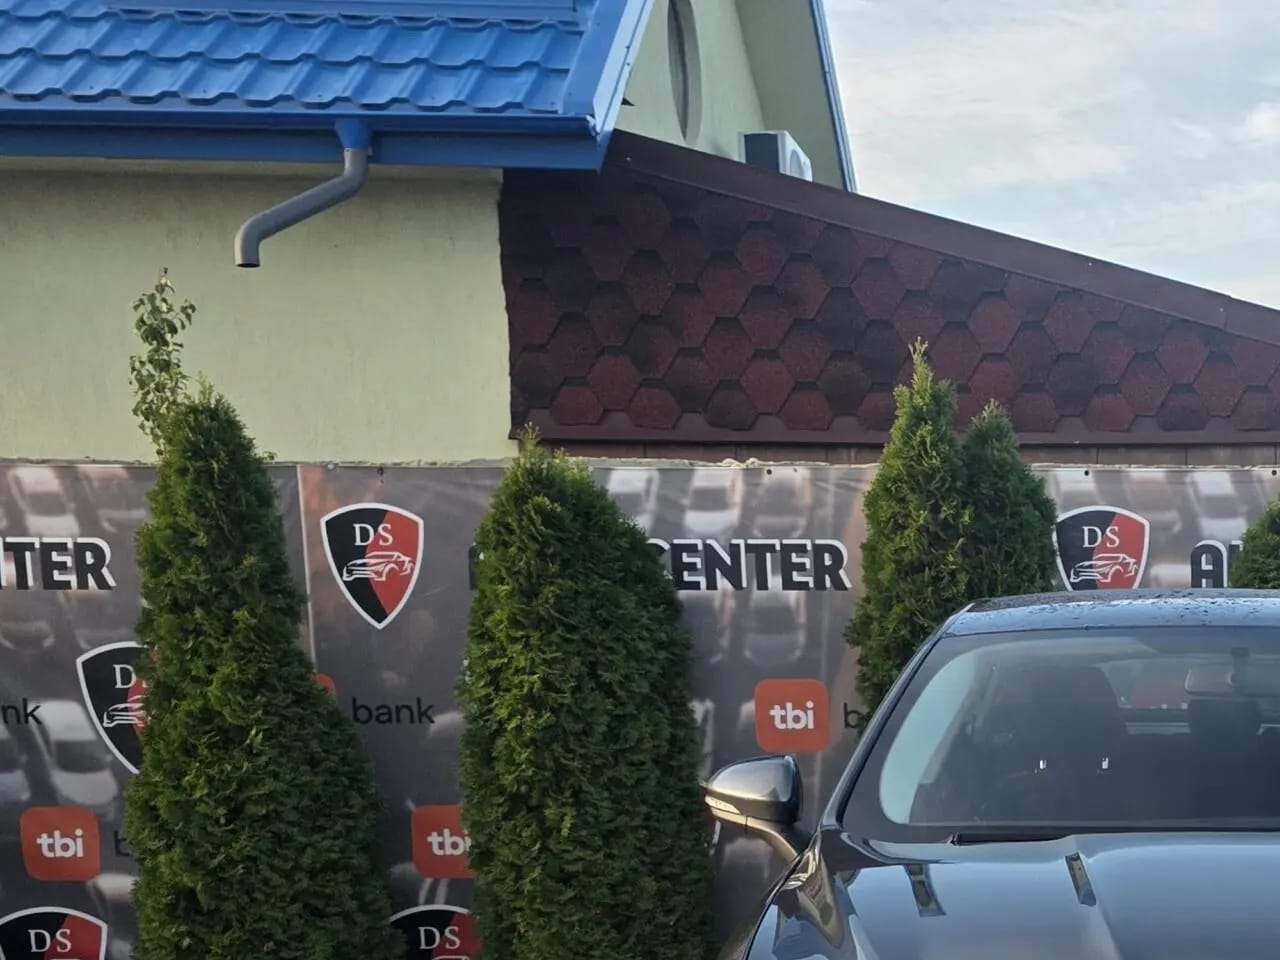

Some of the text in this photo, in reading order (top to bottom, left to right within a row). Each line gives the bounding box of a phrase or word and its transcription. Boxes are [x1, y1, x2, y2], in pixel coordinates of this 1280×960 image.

[353, 523, 394, 547] DS
[1081, 525, 1121, 548] DS
[0, 536, 117, 590] TER
[1, 697, 43, 726] nk
[352, 698, 435, 726] bank
[769, 700, 815, 729] tbi
[36, 829, 84, 858] tbi
[29, 929, 73, 954] DS
[418, 925, 461, 950] DS
